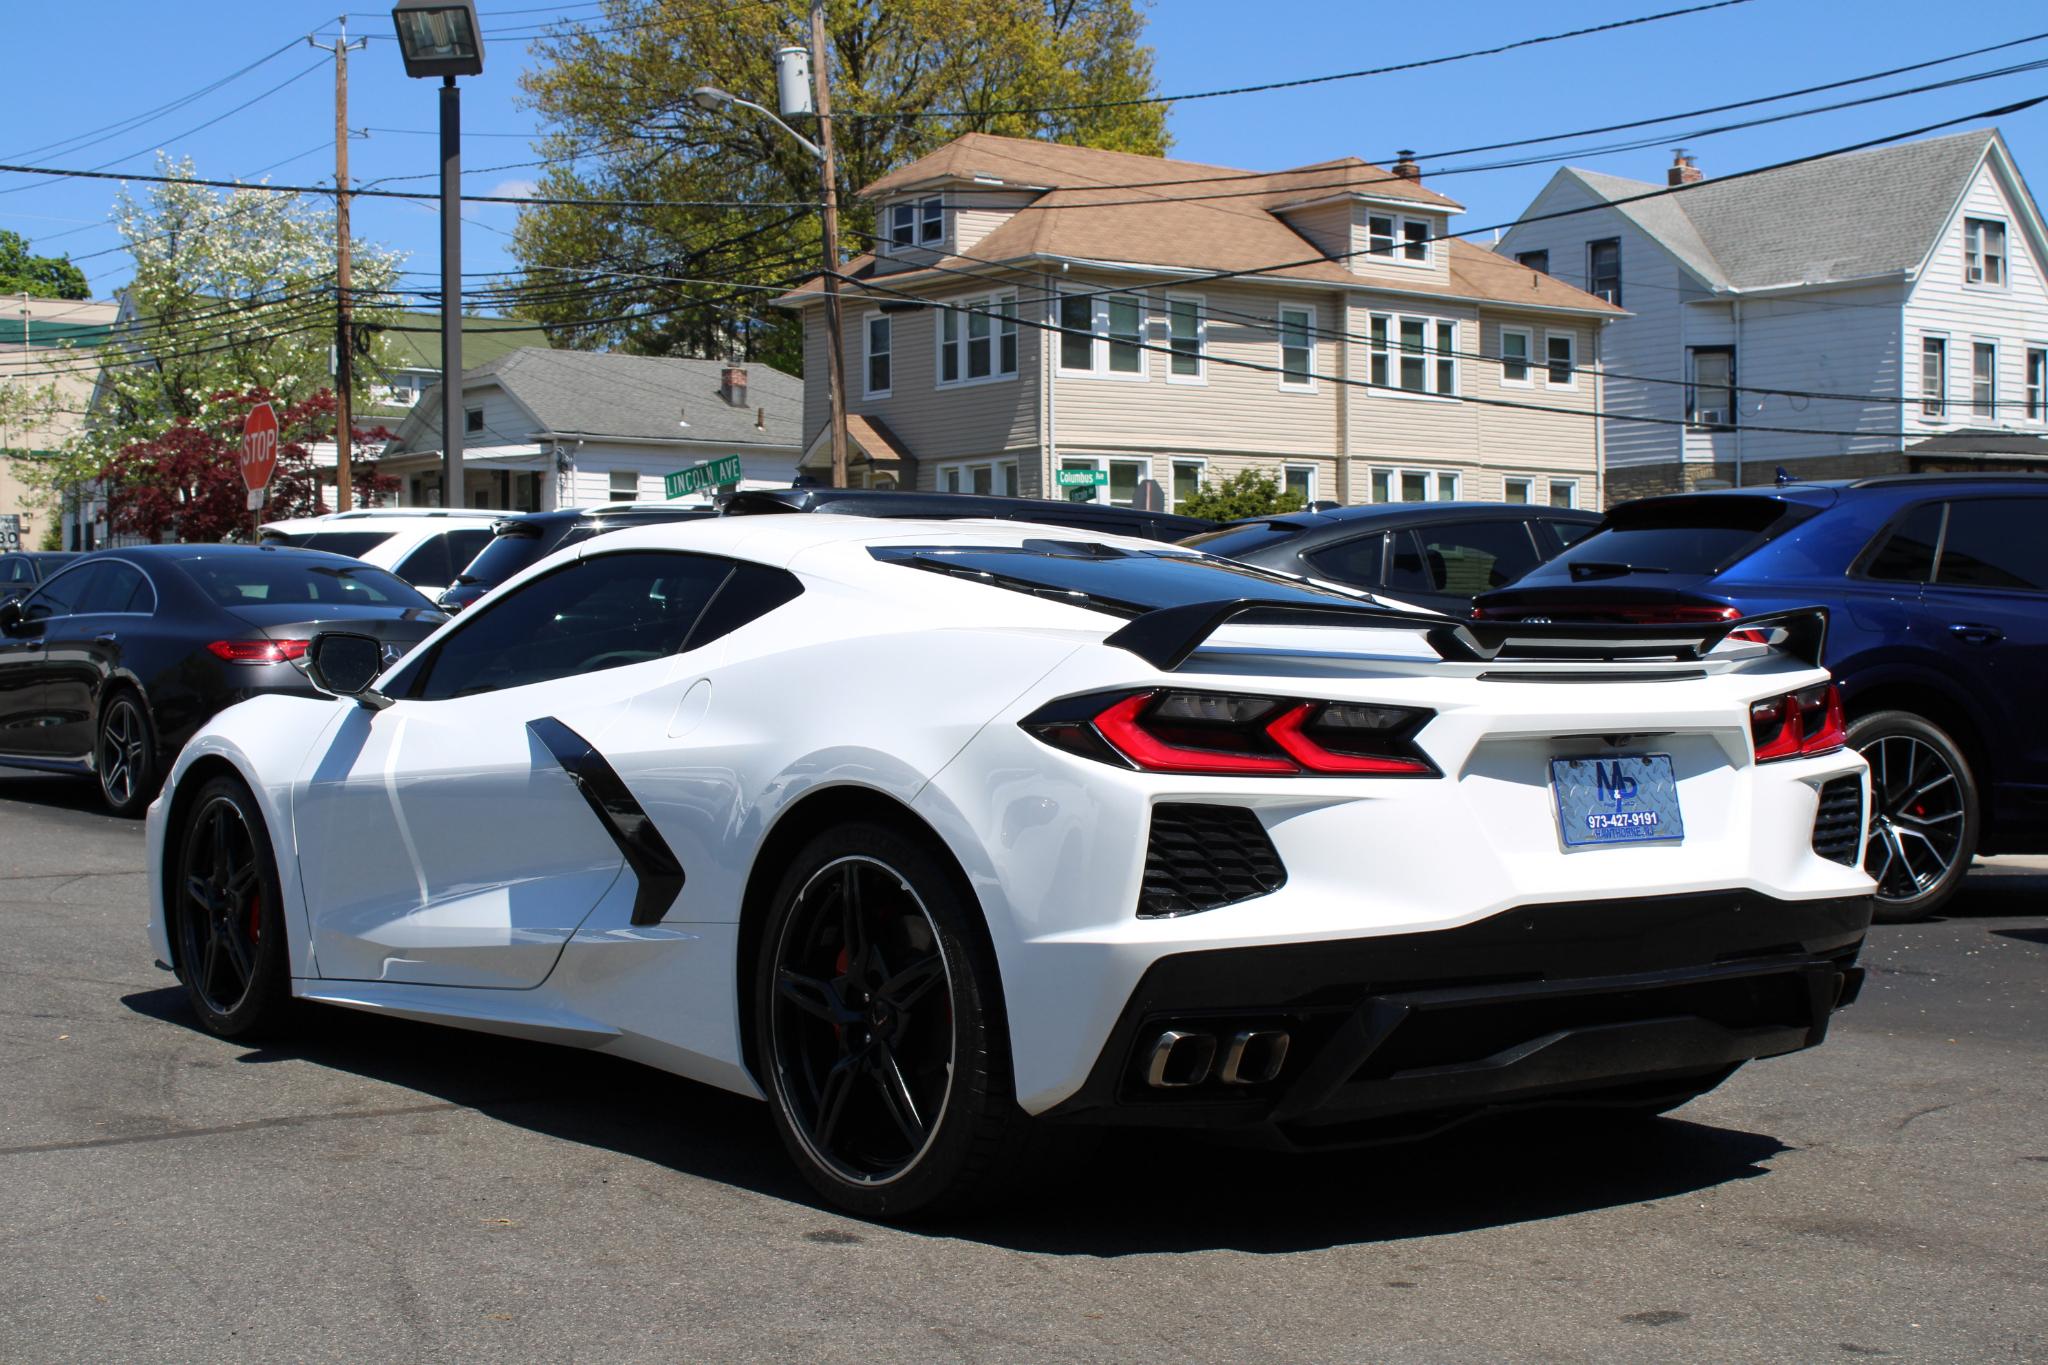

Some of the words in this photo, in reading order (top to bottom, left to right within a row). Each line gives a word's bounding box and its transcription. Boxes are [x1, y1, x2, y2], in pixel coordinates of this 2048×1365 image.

[243, 428, 275, 466] STOP
[666, 466, 715, 496] LINCOLN
[719, 458, 740, 481] AVE
[1060, 471, 1094, 483] Columbus
[1588, 812, 1658, 829] 973-427-9191
